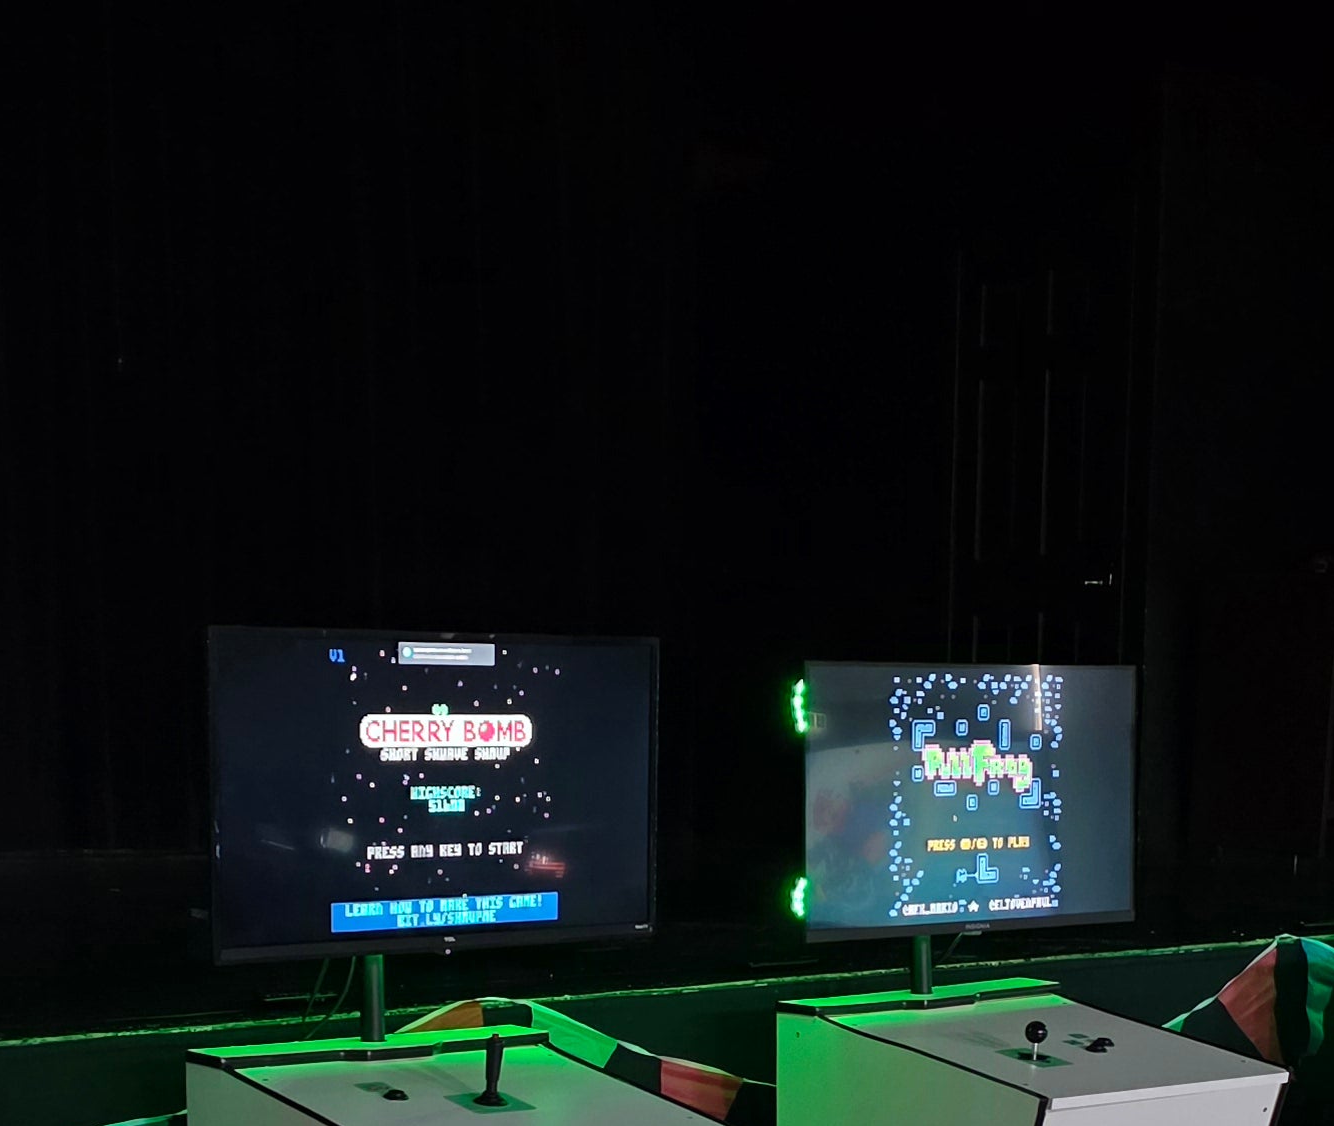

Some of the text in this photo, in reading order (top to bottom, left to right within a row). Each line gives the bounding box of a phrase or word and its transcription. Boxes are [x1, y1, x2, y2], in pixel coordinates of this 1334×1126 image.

[366, 720, 526, 742] CHERRY BOMB
[367, 845, 405, 860] PRESS
[467, 842, 483, 856] TO
[488, 841, 524, 855] START
[344, 903, 383, 917] LEARN
[419, 901, 434, 913] TO
[475, 896, 503, 910] THIS
